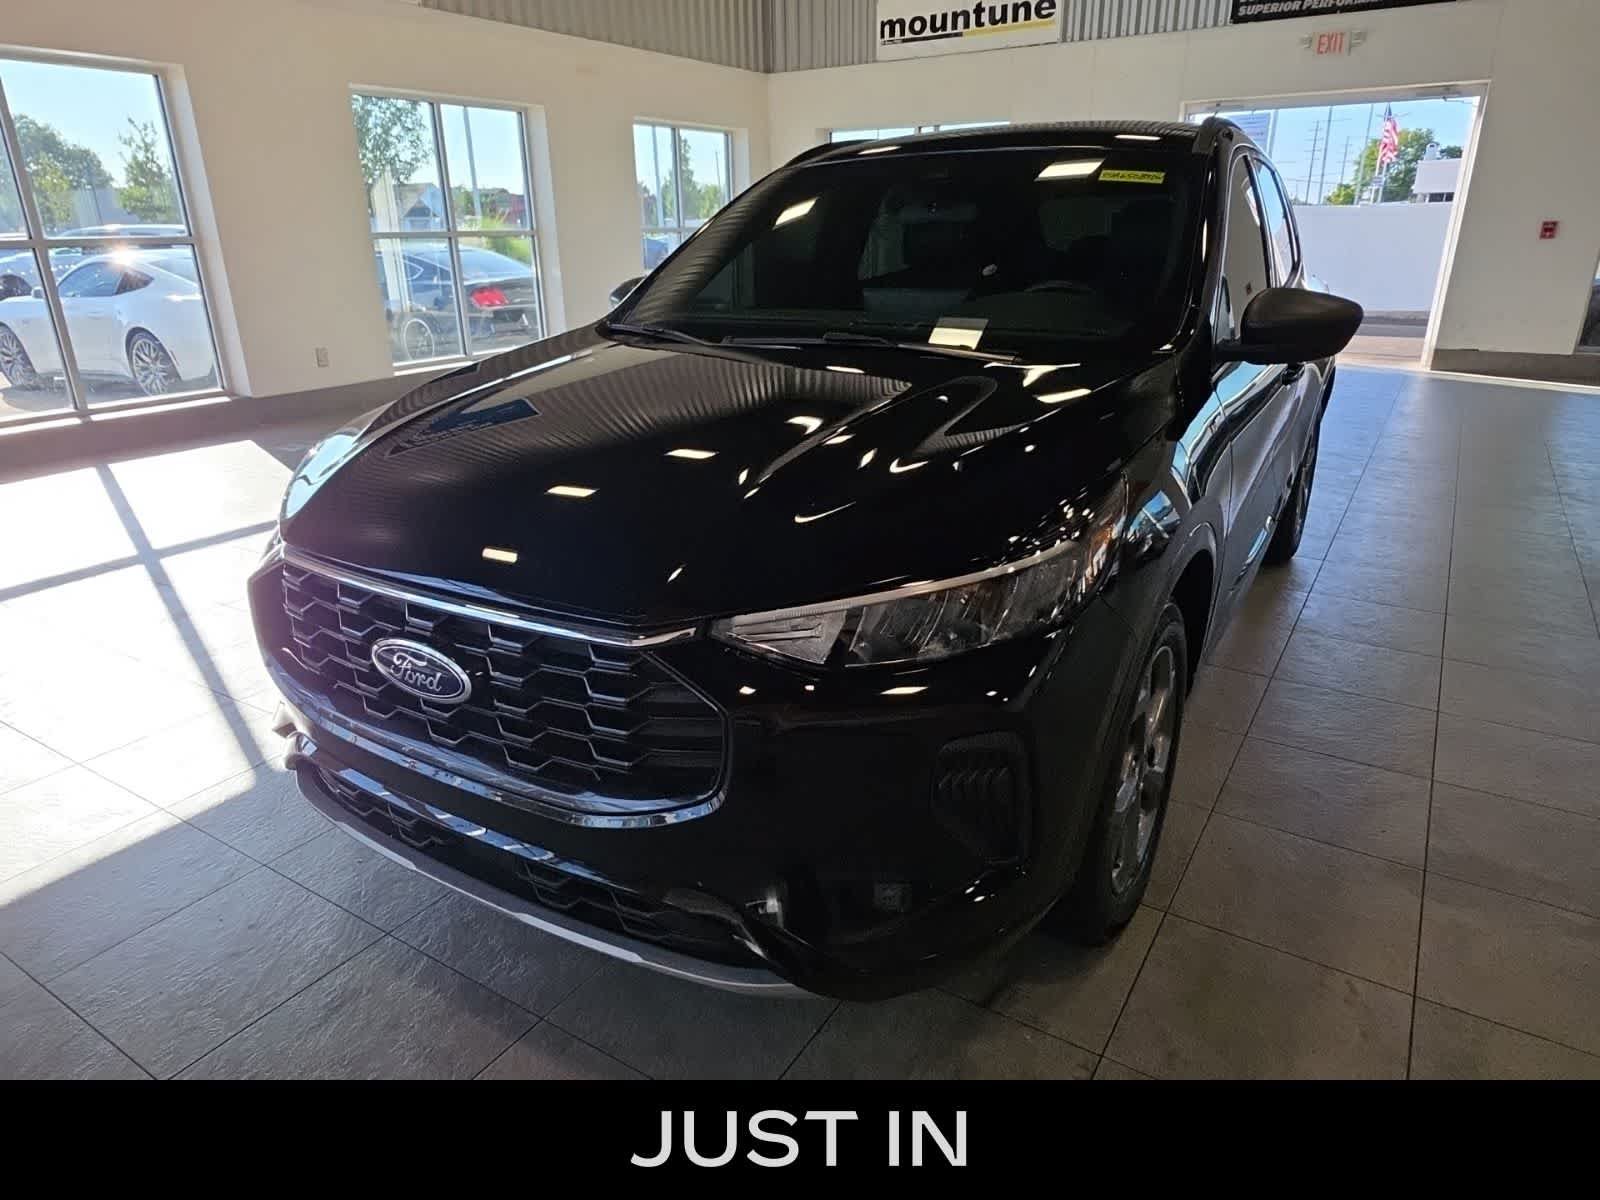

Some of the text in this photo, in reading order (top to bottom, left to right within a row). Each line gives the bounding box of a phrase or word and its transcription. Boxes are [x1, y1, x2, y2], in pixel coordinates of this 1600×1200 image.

[880, 0, 1056, 39] mountune
[1238, 1, 1301, 16] SUPERIOR
[1316, 32, 1345, 55] EXIT
[390, 651, 442, 692] Ford
